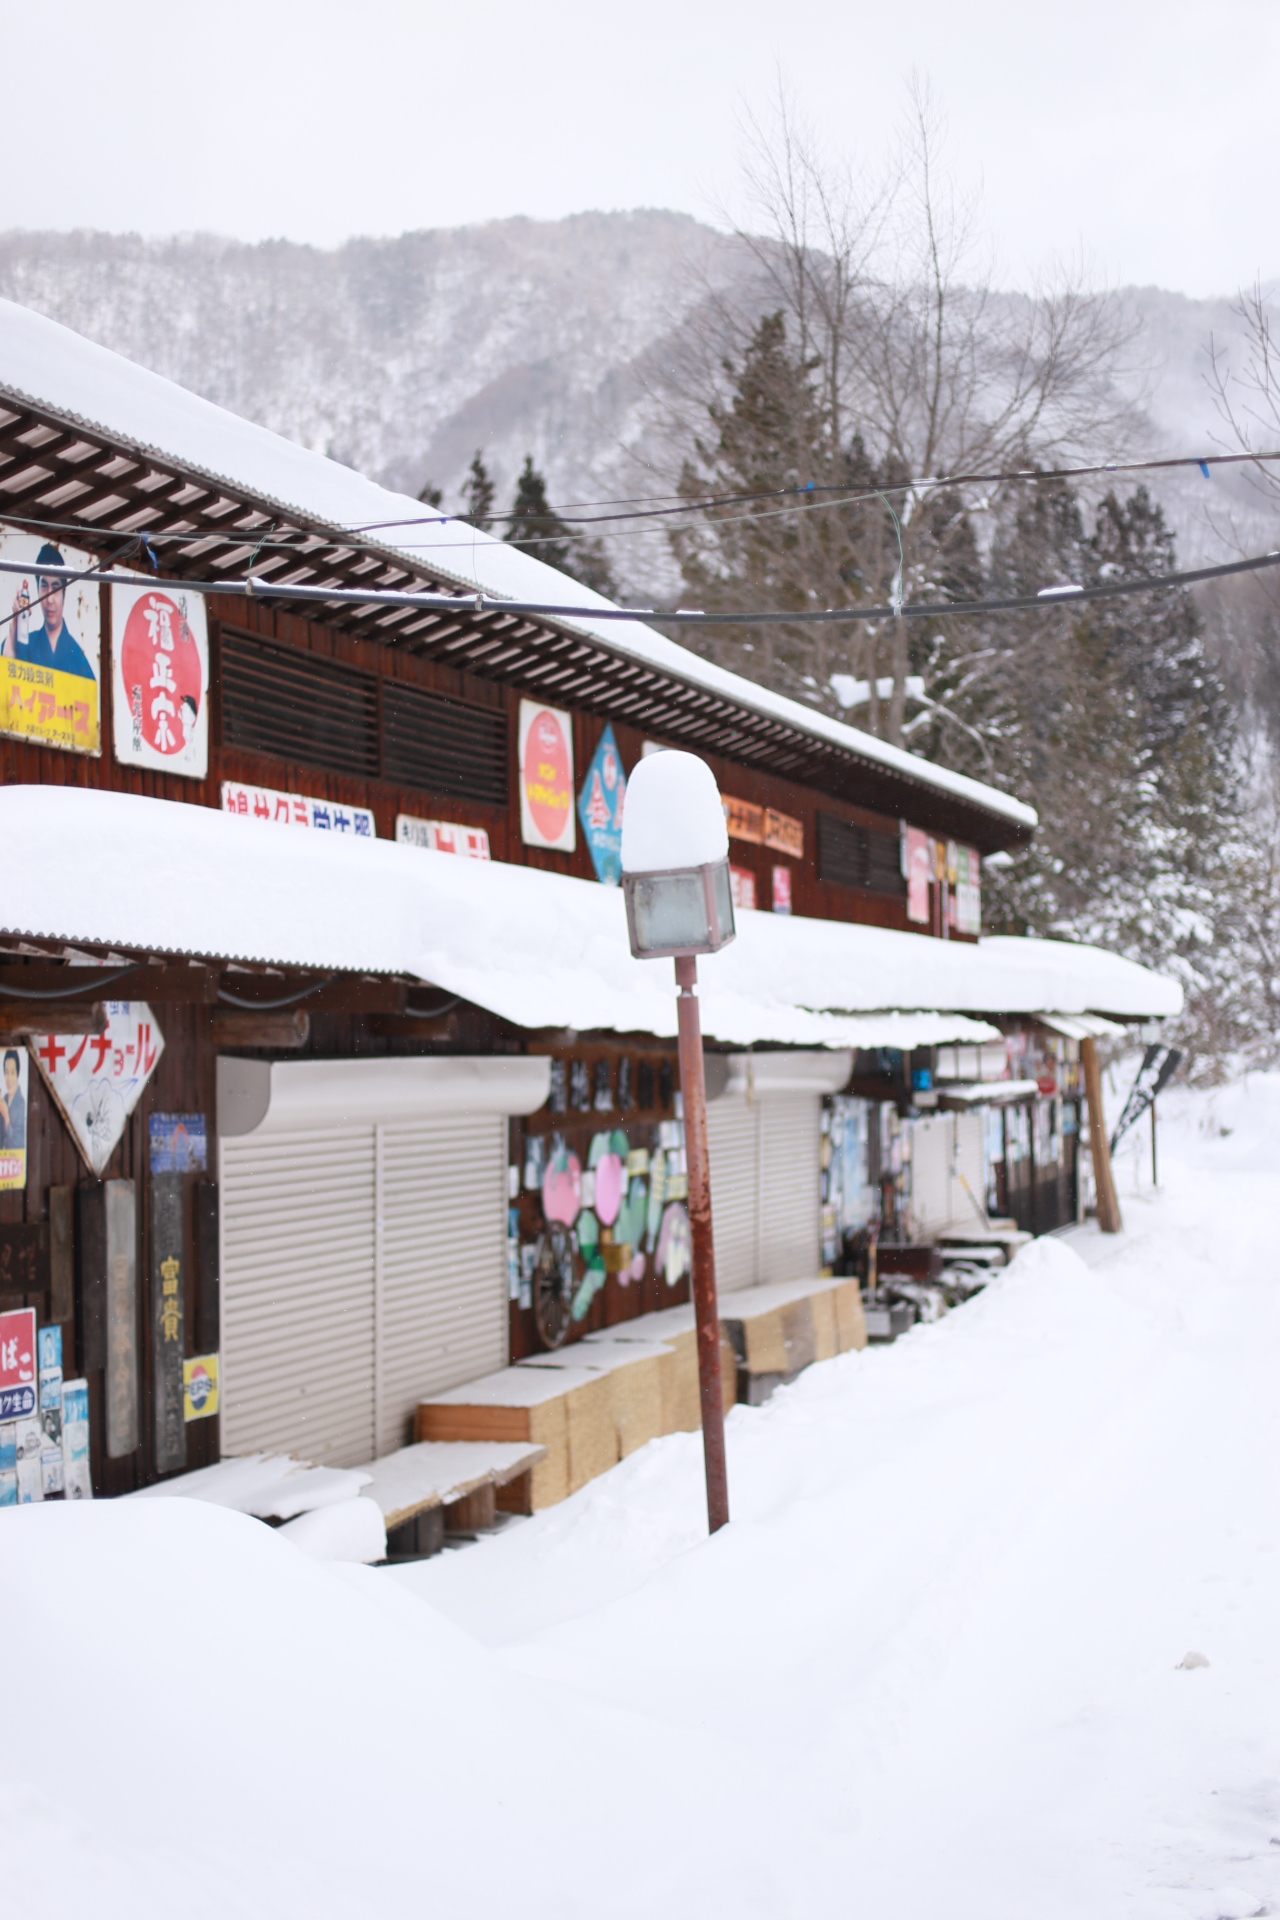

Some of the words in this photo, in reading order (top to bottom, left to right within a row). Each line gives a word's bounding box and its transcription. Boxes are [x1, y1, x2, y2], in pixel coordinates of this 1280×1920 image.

[9, 684, 90, 736] ハイアース
